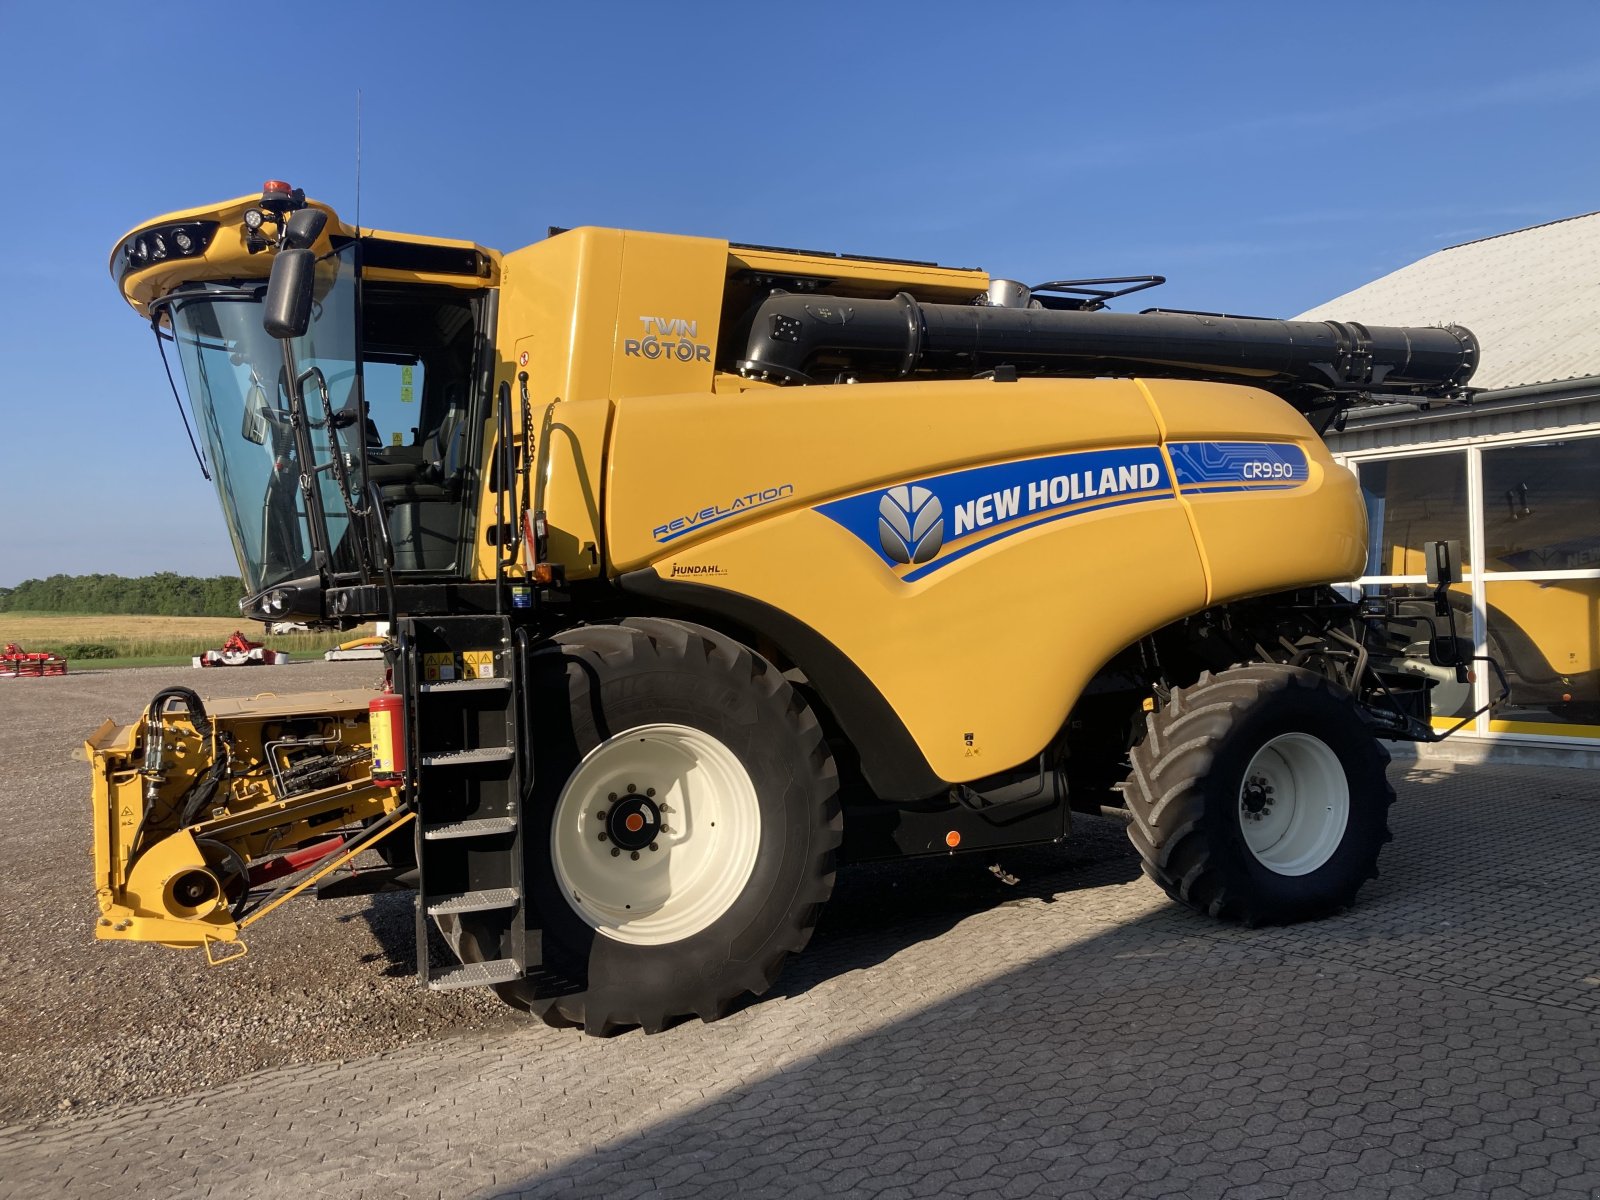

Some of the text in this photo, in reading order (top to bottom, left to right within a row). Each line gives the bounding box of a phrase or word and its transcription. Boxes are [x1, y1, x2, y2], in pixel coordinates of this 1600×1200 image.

[640, 316, 697, 338] TWIN
[624, 335, 711, 362] ROTOR
[1243, 462, 1293, 478] CR9.90
[652, 484, 794, 539] REVELATION
[954, 463, 1160, 536] NEW HOLLAND
